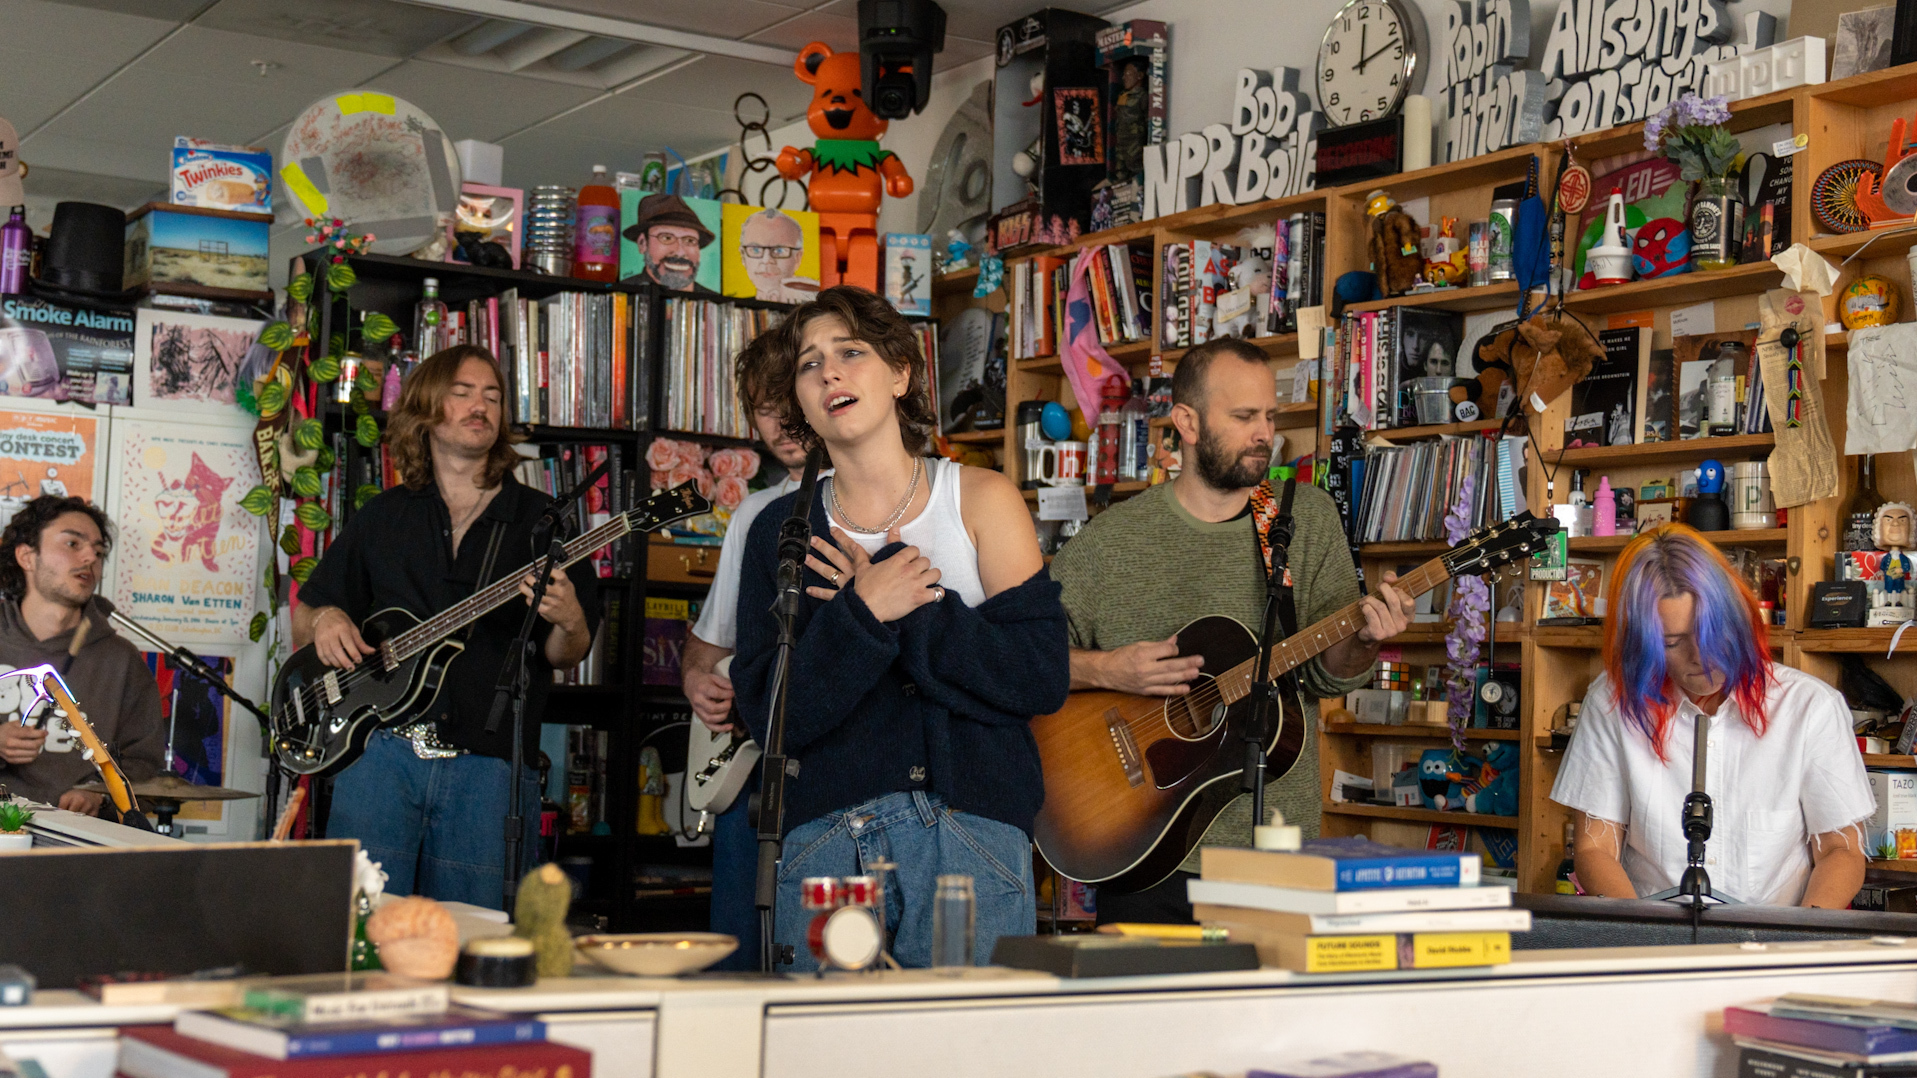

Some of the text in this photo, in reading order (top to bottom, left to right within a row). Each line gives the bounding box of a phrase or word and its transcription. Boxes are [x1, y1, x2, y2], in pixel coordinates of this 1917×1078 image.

[1358, 6, 1370, 20] 12
[1379, 7, 1383, 20] 1
[1343, 18, 1351, 32] 11
[1388, 22, 1397, 36] 2
[1153, 33, 1164, 43] P
[1441, 0, 1511, 88] Robin
[1330, 41, 1340, 55] 10
[1394, 46, 1402, 60] 3
[1152, 48, 1165, 109] MASTER
[1325, 69, 1334, 82] 9
[1390, 74, 1398, 87] 4
[1720, 51, 1798, 96] npr
[1232, 66, 1296, 138] Bob
[1330, 93, 1340, 105] 8
[1378, 97, 1387, 110] 5
[1342, 107, 1351, 121] 7
[1360, 109, 1369, 122] 6
[1438, 66, 1526, 163] Hilton
[179, 162, 244, 188] Twinkies
[1143, 124, 1235, 221] NPR
[1777, 187, 1788, 195] MY
[4, 300, 134, 332] Smoke Alarm
[16, 433, 38, 441] desk
[40, 434, 75, 445] concert
[0, 440, 80, 458] ONTEST
[1531, 568, 1565, 579] PRODUCTION
[179, 579, 244, 595] DEACON
[132, 592, 242, 609] SHARON Van ETTEN
[1892, 778, 1914, 789] TAZO
[1427, 947, 1446, 955] David
